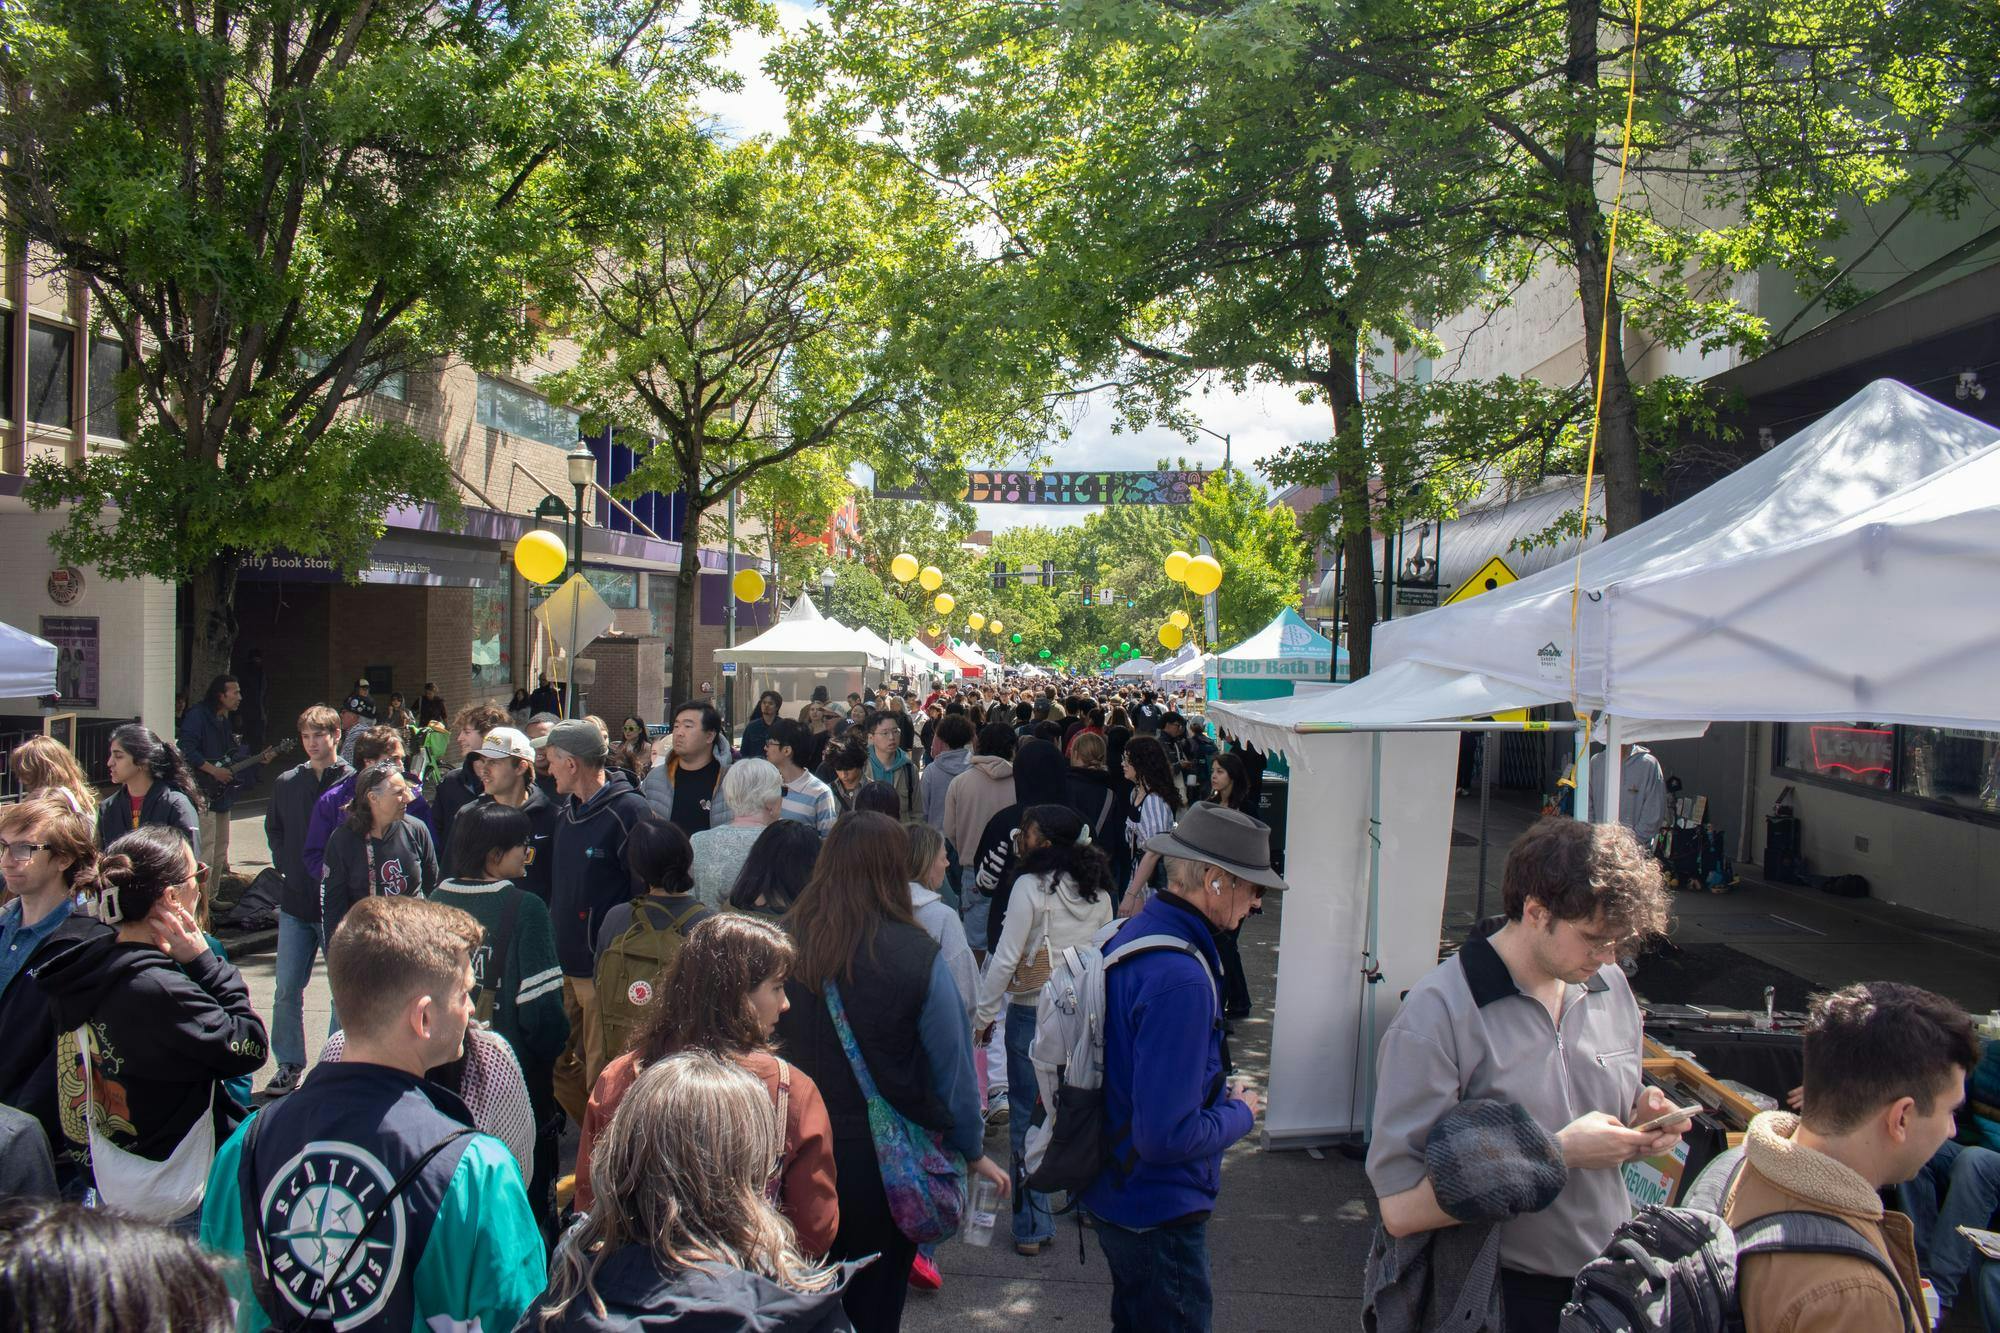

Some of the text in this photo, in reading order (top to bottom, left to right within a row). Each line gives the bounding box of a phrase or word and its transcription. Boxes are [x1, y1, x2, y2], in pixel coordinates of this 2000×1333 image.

[974, 484, 1052, 492] STREET
[272, 556, 302, 568] Book
[370, 559, 431, 575] University Book Store
[1221, 659, 1261, 674] CBD
[1265, 660, 1309, 674] Bath
[1625, 1167, 1667, 1206] REVIVING
